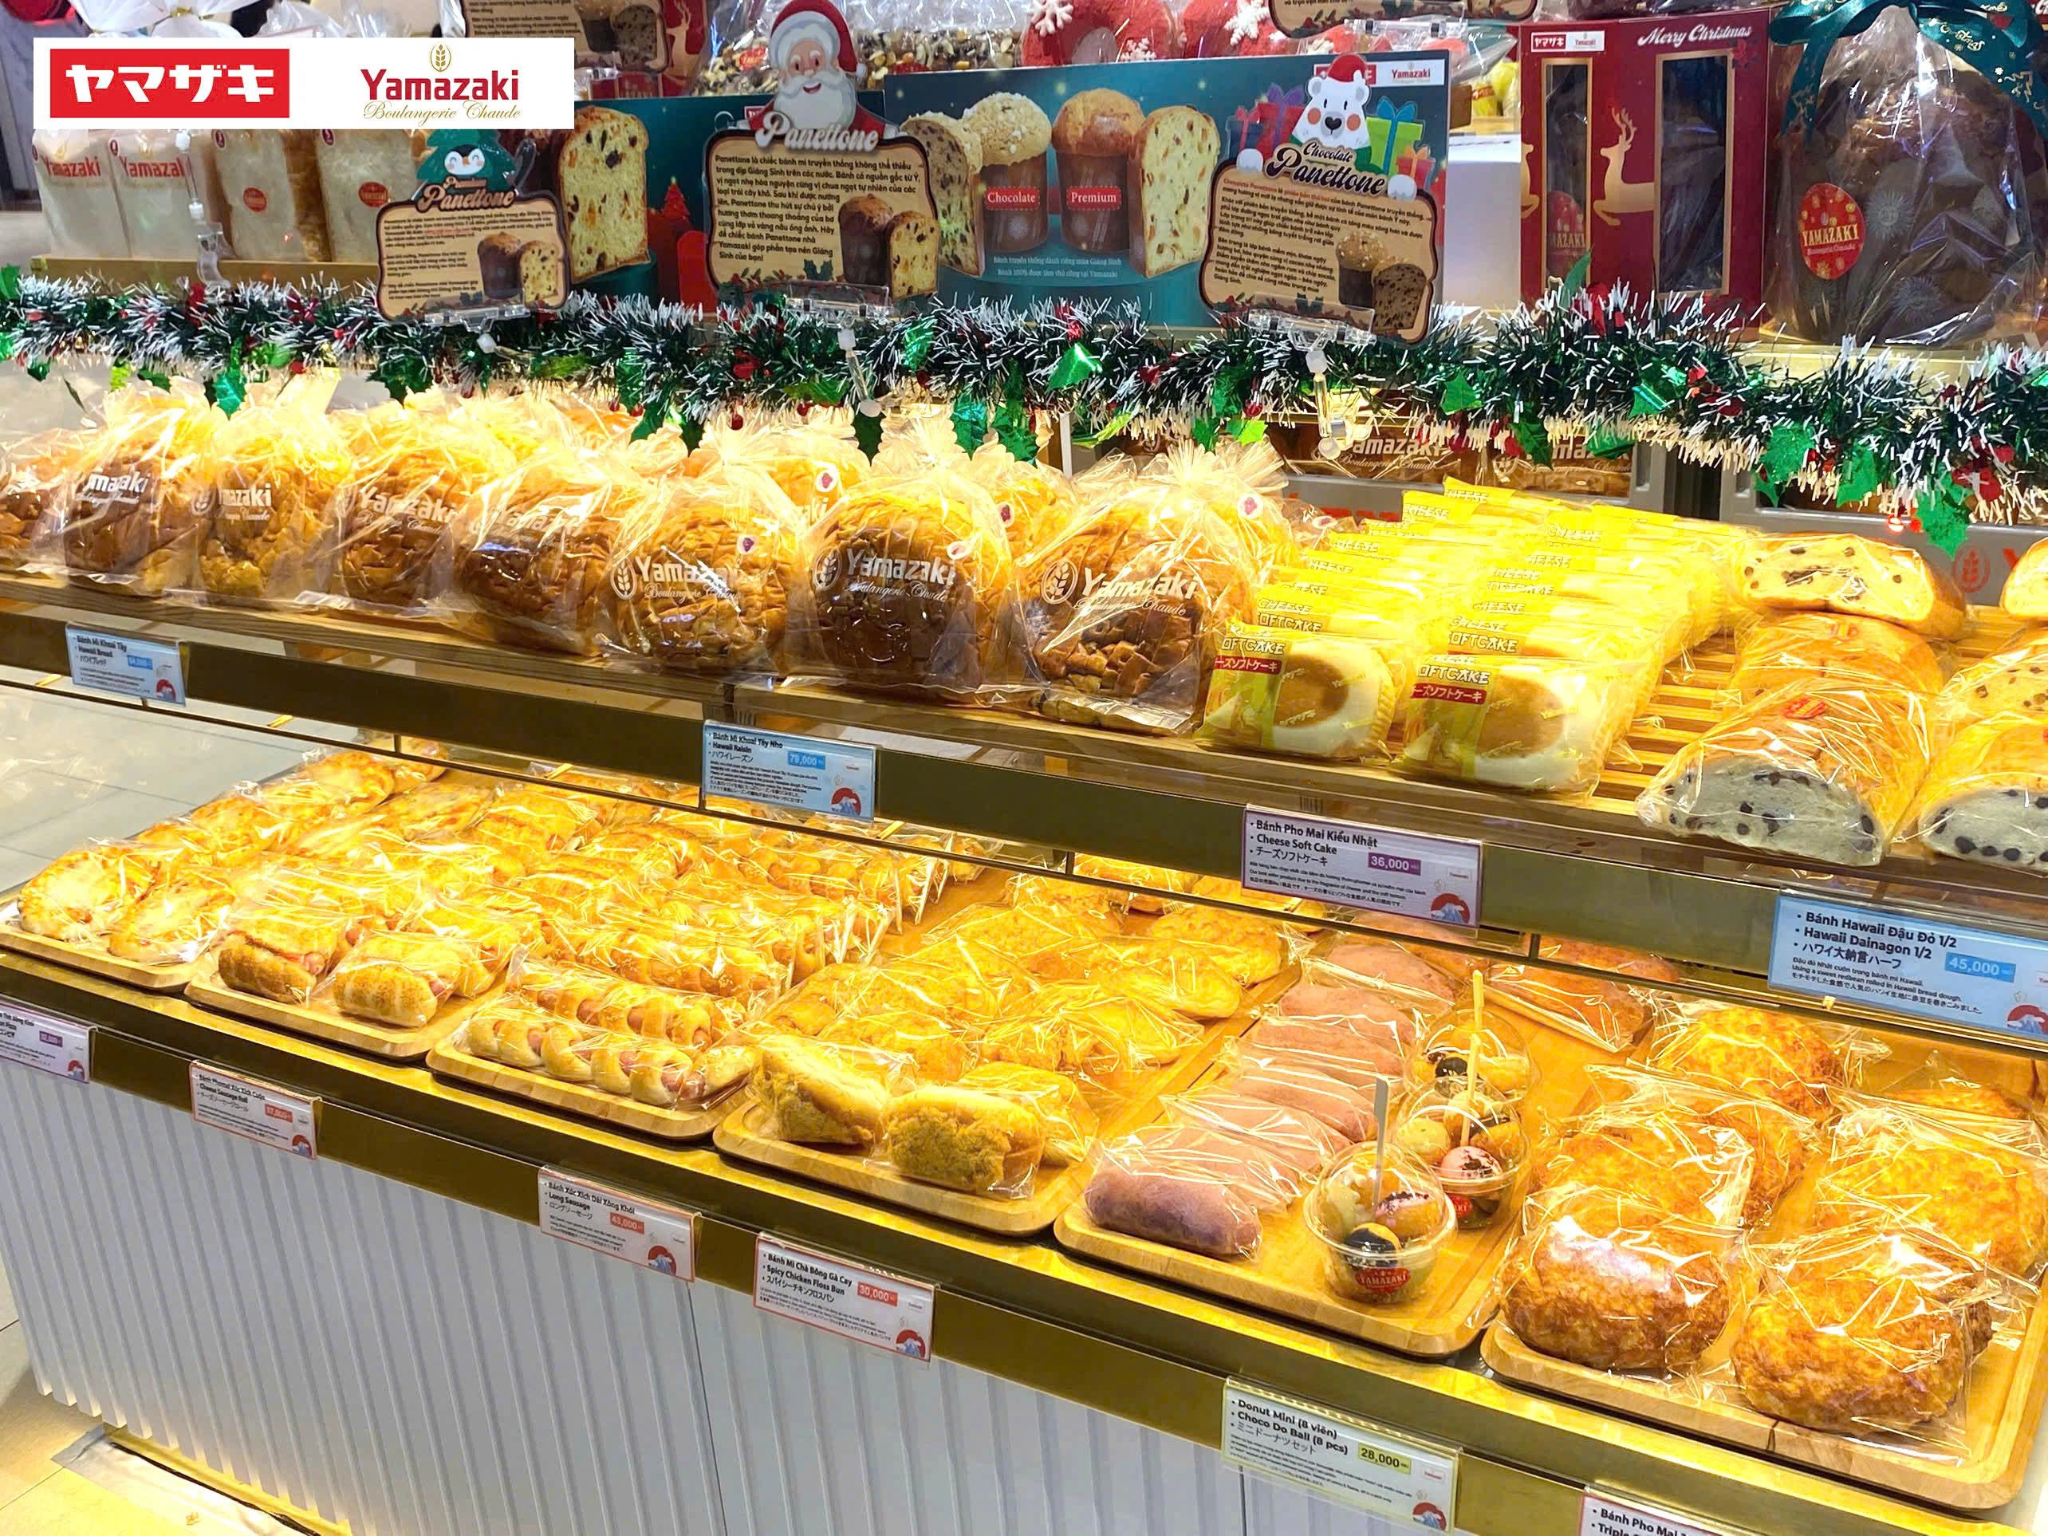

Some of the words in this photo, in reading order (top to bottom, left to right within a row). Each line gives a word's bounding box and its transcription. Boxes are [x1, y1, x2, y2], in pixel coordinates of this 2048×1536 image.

[1638, 28, 1689, 48] Merry
[1689, 23, 1752, 40] Christmas
[1392, 67, 1431, 80] Yamazaki
[755, 111, 879, 151] Panettone
[1303, 142, 1353, 164] Chocolate
[40, 155, 102, 177] Yamazaki
[1267, 147, 1386, 195] Panettone
[416, 185, 515, 211] Panettone
[987, 191, 1036, 203] Chocolate
[1071, 191, 1117, 203] Premium
[1802, 223, 1859, 246] YAMAZAKI
[846, 548, 956, 585] Yamazaki
[1082, 567, 1200, 600] Yamazaki
[1221, 637, 1286, 655] OFTCAKE
[1418, 664, 1490, 685] OFTCAKE
[1256, 819, 1281, 832] Bánh
[1284, 823, 1303, 836] Pho
[1305, 827, 1324, 839] Mai
[1327, 830, 1349, 842] Kiểu
[1352, 834, 1377, 847] Nhật
[1257, 833, 1290, 847] Cheese
[1292, 839, 1311, 850] Soft
[1313, 842, 1336, 854] Cake
[1255, 846, 1327, 866] チーズソフトケーキ
[1371, 855, 1409, 871] 36,000
[1806, 911, 1838, 926] Bánh
[1841, 918, 1884, 935] Hawaii
[1887, 926, 1913, 941] Đậu
[1917, 931, 1935, 944] Đỏ
[1939, 935, 1956, 947] 1/2
[1804, 926, 1846, 943] Hawaii
[1849, 934, 1910, 955] Dainagon
[1915, 946, 1931, 959] 1/2
[1802, 943, 1901, 968] ハワイ大納言ハーフ
[1949, 957, 2000, 975] 45,000
[767, 1264, 784, 1277] Spicy
[785, 1270, 811, 1284] Chicken
[813, 1278, 829, 1290] Floss
[831, 1284, 844, 1295] Bun
[768, 1253, 785, 1265] Bánh
[786, 1258, 794, 1268] Mì
[795, 1262, 808, 1272] Chà
[809, 1266, 827, 1280] Bông
[828, 1272, 837, 1281] Gà
[839, 1276, 851, 1287] Cay
[859, 1285, 889, 1301] 30,000
[1238, 1399, 1269, 1416] Donut
[1273, 1410, 1295, 1424] Mini
[1298, 1418, 1307, 1429] (8
[1311, 1424, 1336, 1440] viên)
[1237, 1411, 1270, 1427] Choco
[1272, 1422, 1287, 1433] Do
[1290, 1428, 1309, 1441] Ball
[1312, 1435, 1322, 1445] (8
[1325, 1441, 1347, 1455] pcs)
[1361, 1448, 1400, 1468] 28,000
[1600, 1508, 1629, 1525] Bánh
[1632, 1518, 1653, 1532] Pho
